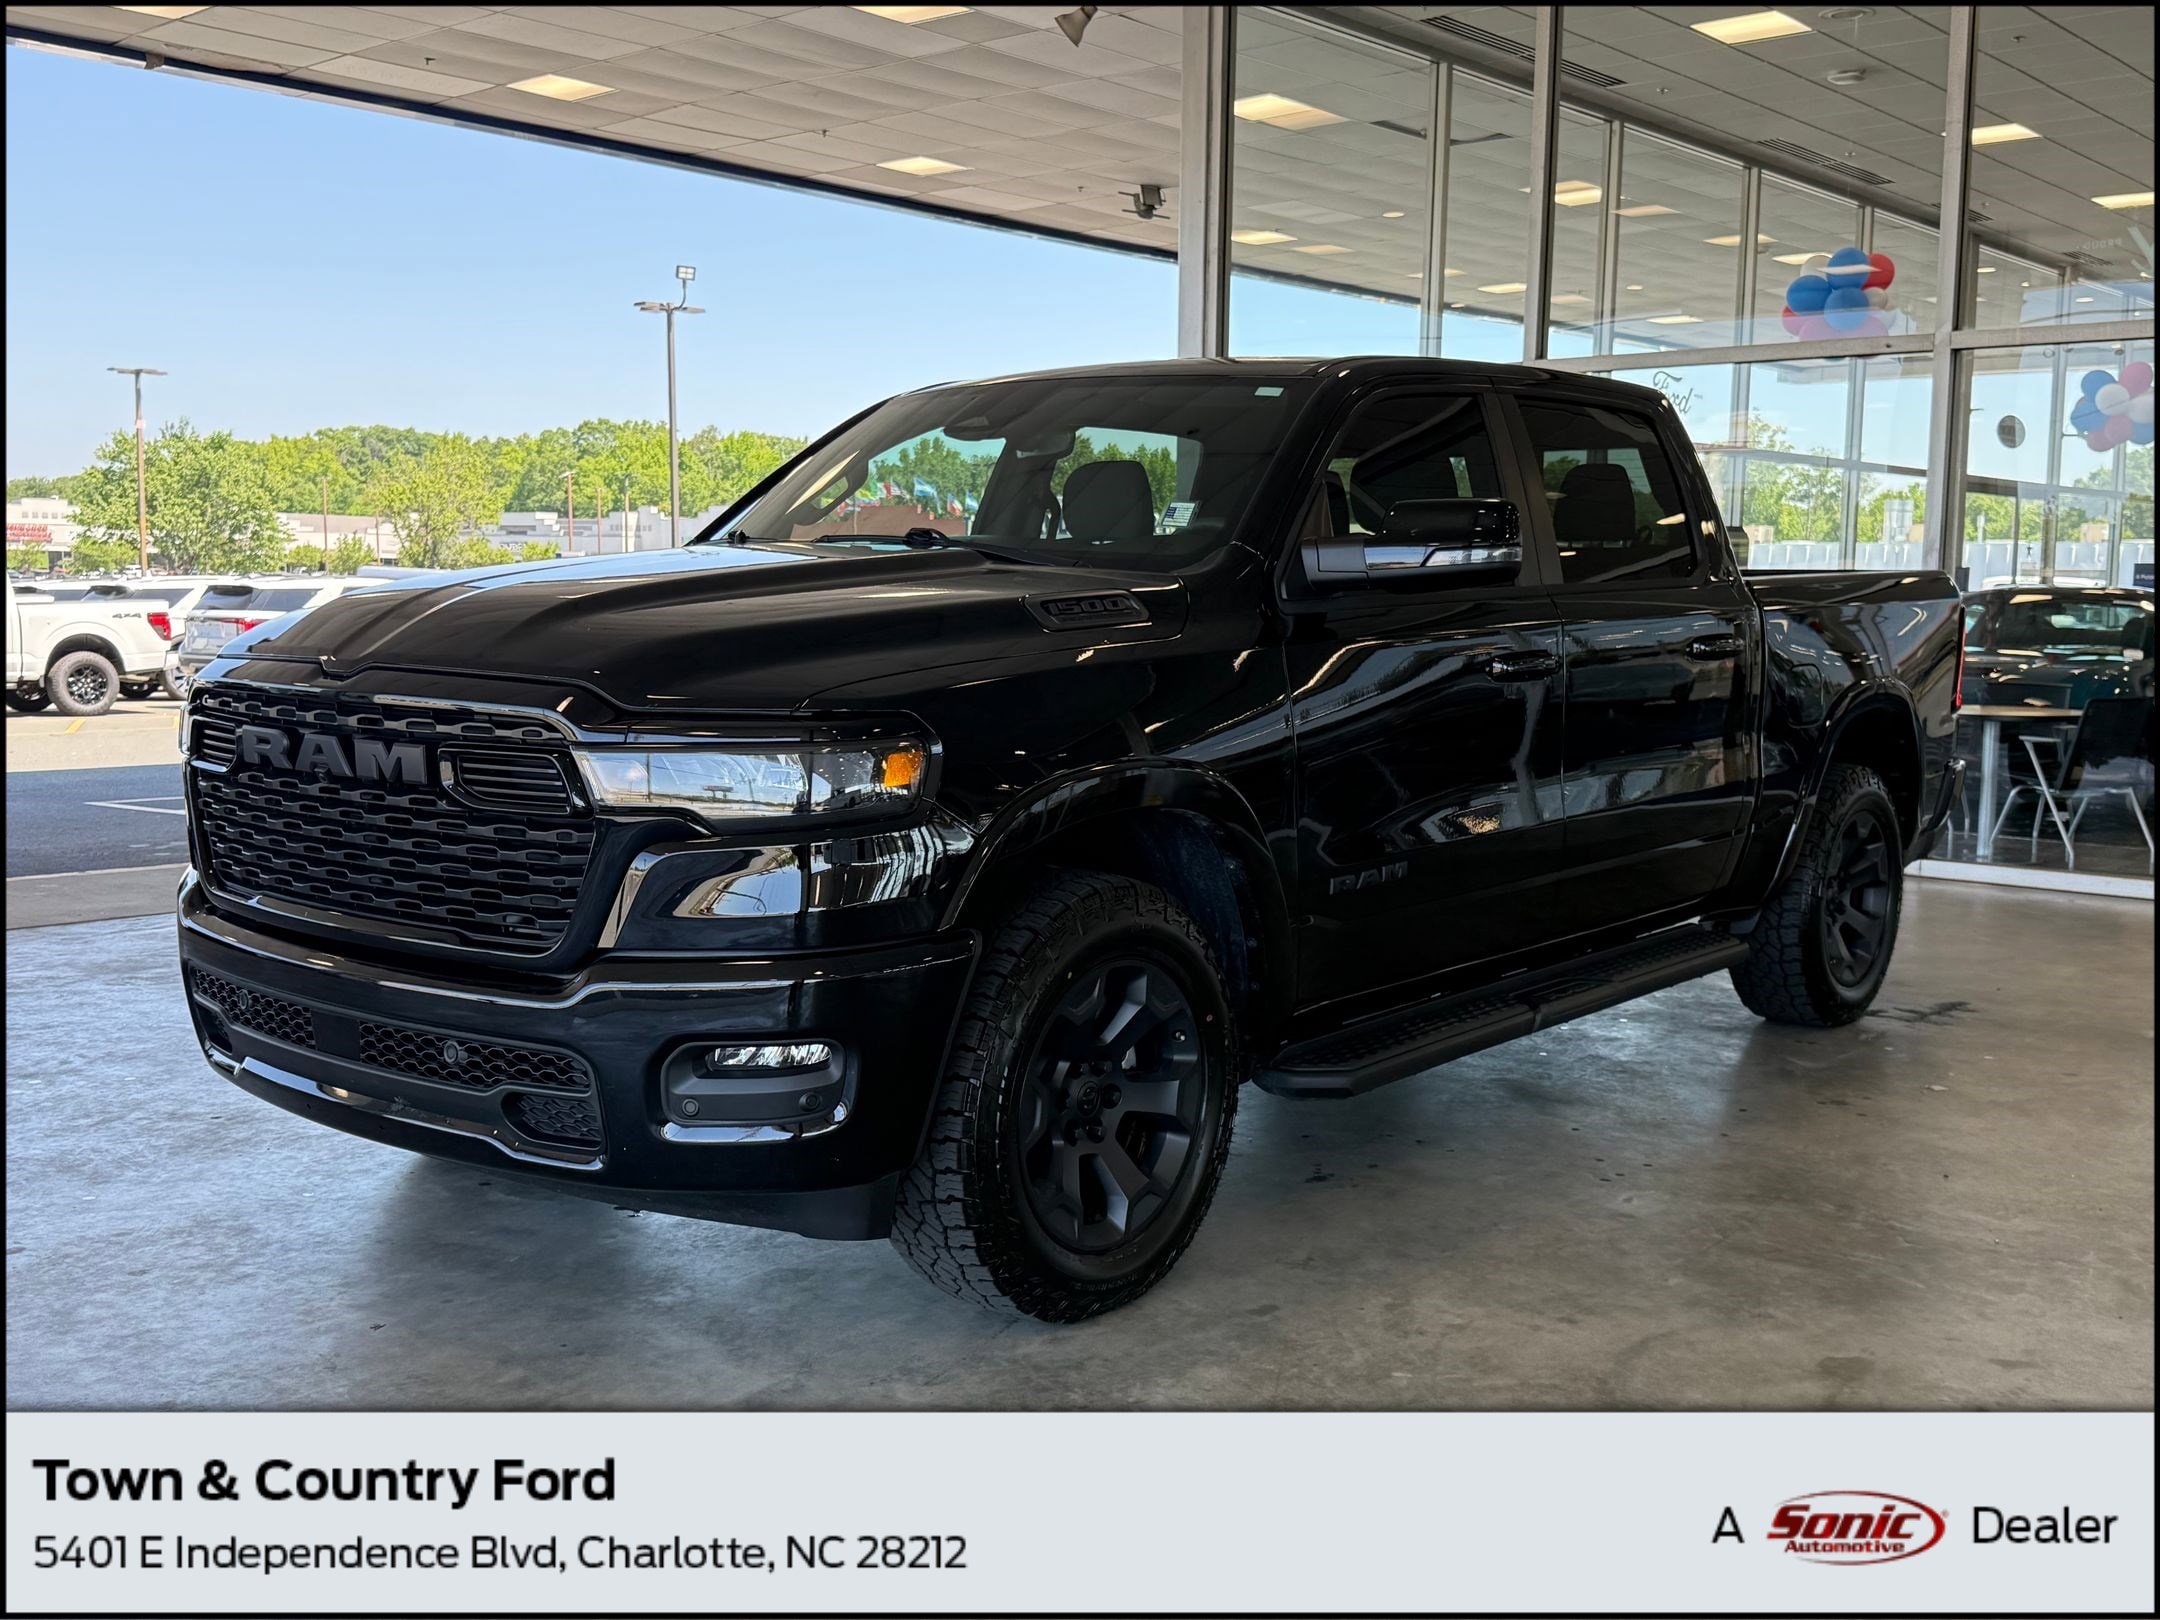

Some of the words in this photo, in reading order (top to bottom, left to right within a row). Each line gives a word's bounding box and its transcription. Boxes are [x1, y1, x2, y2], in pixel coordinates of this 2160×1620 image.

[1653, 370, 1693, 414] Frd
[1044, 597, 1127, 615] 1500
[242, 724, 428, 785] RAM
[1329, 861, 1408, 895] RAM
